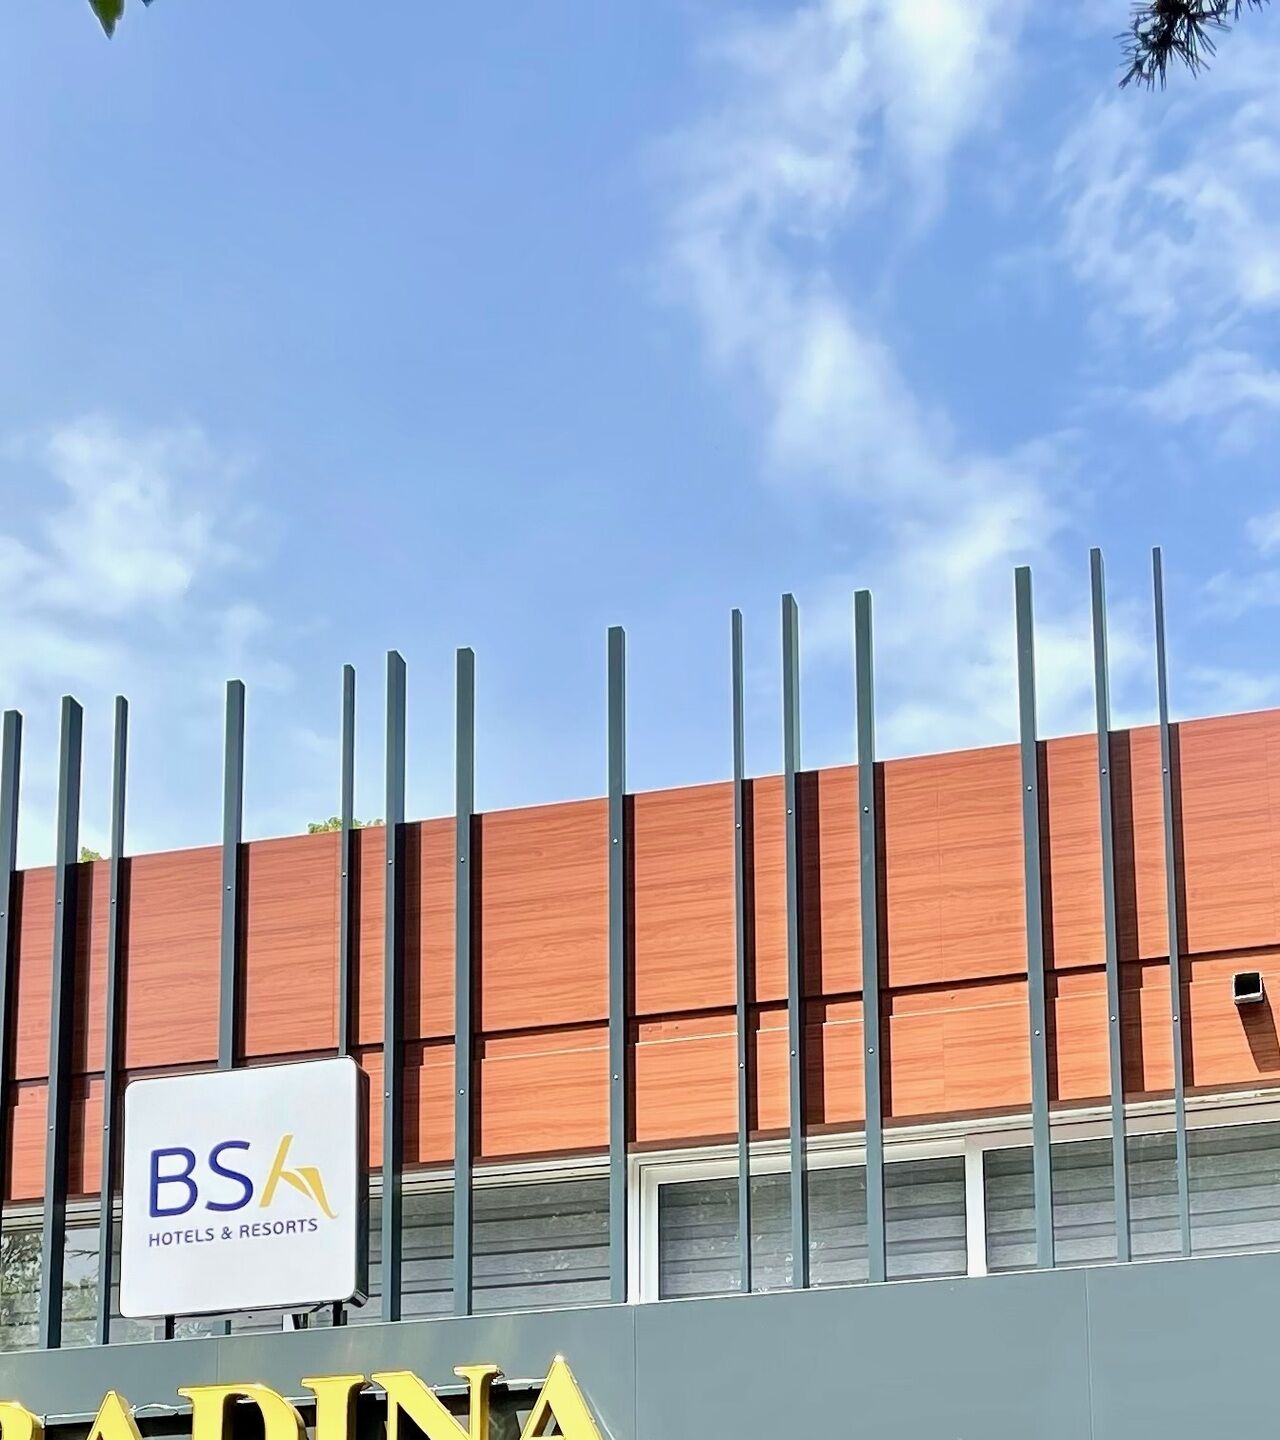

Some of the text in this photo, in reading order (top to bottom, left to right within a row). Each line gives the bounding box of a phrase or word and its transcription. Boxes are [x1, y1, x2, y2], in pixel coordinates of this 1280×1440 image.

[148, 1218, 319, 1248] HOTELS & RESORTS
